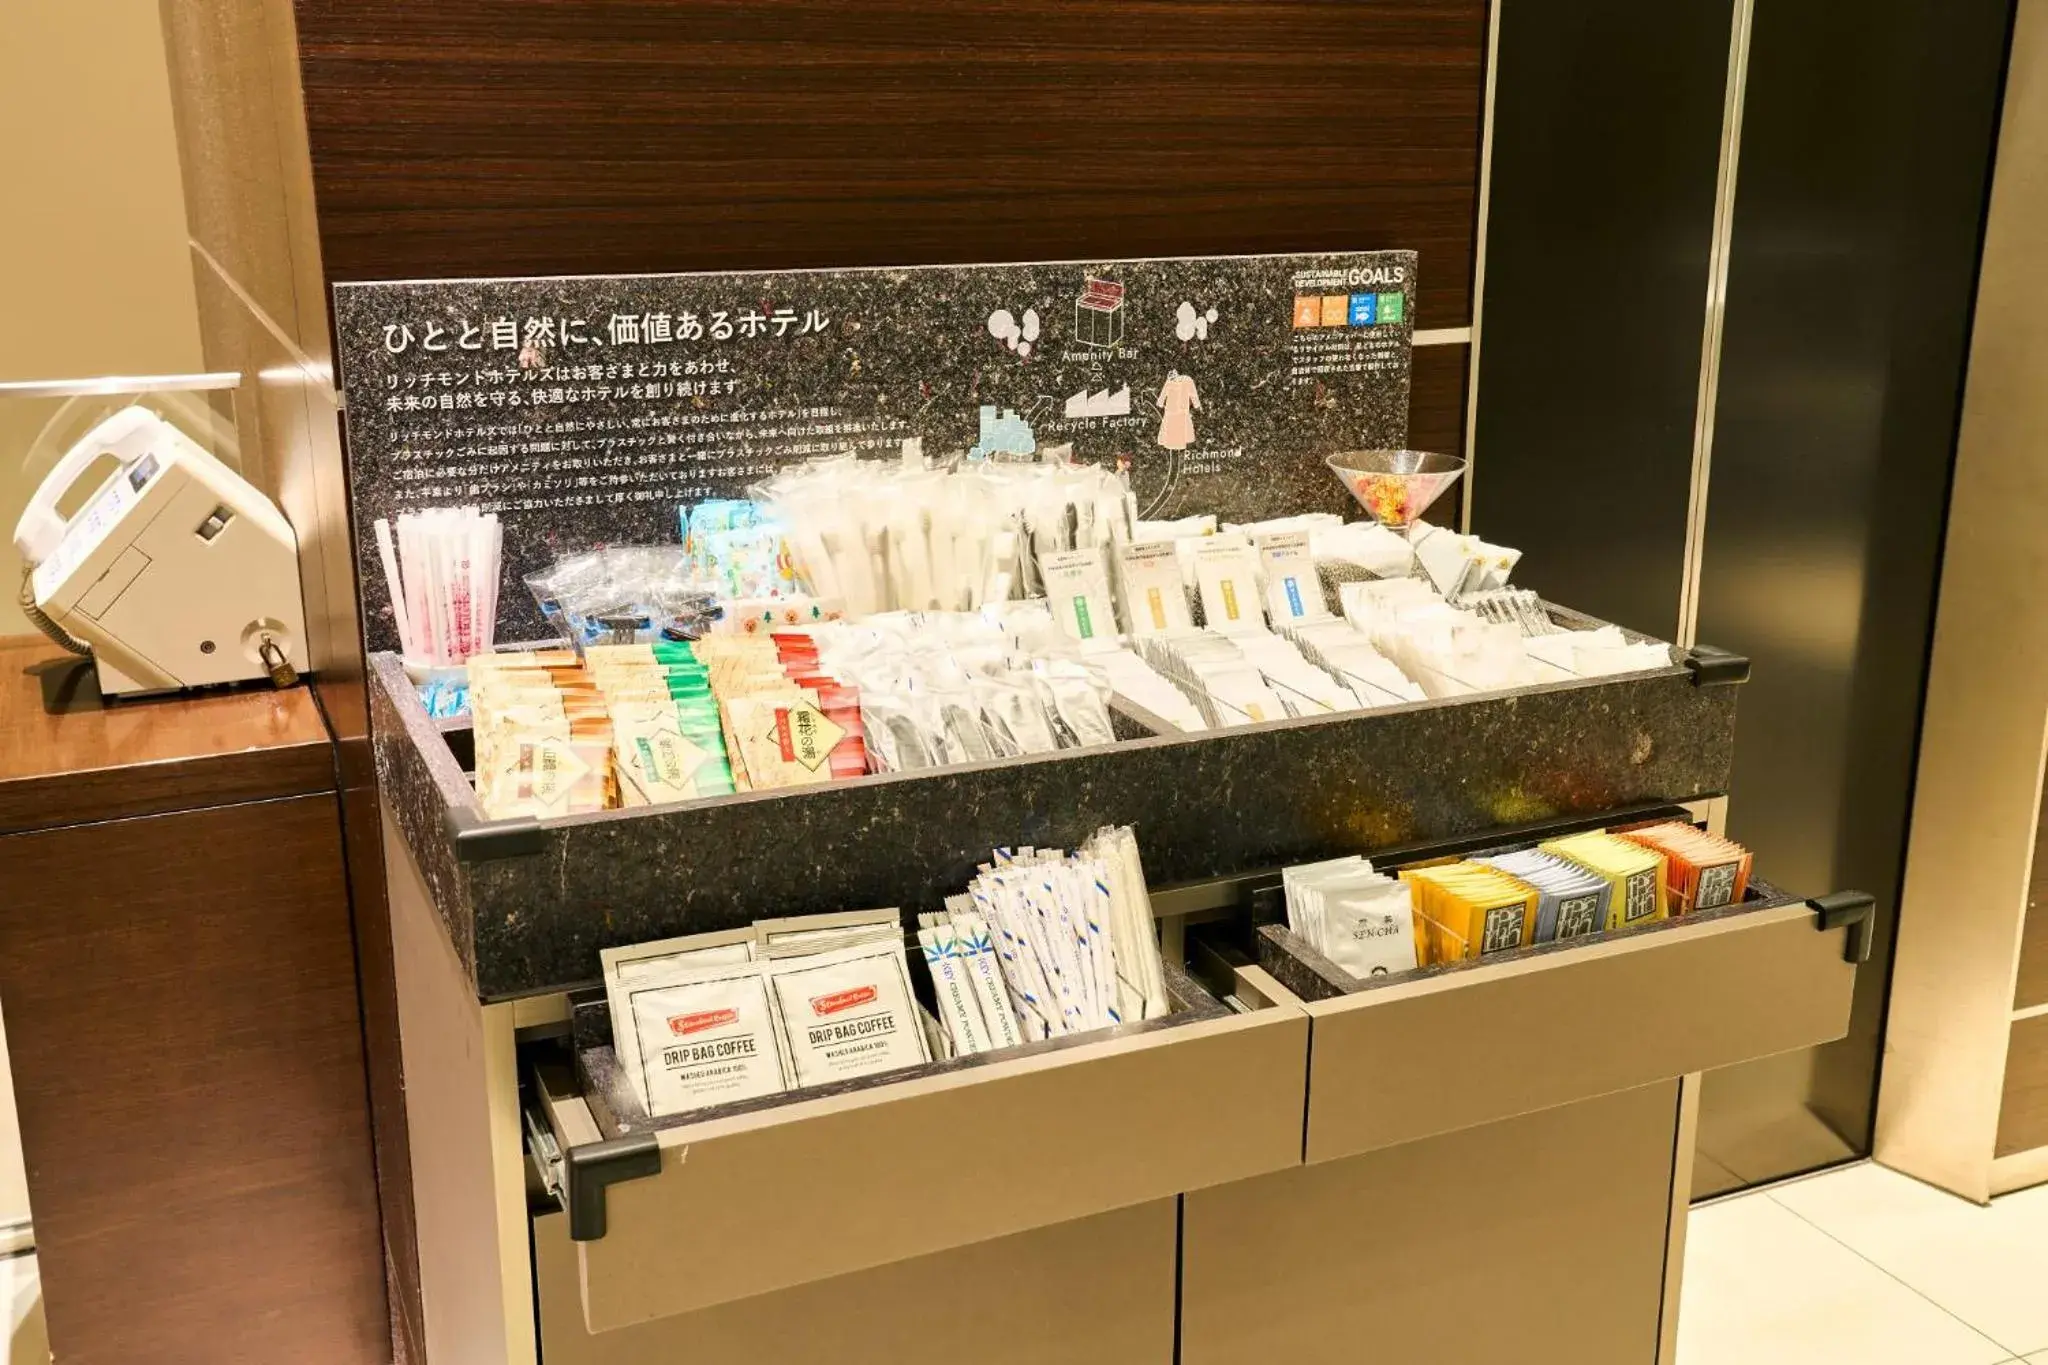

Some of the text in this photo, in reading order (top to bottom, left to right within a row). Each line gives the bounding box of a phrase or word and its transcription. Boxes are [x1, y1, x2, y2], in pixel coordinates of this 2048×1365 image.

[1349, 267, 1404, 285] GOALS
[383, 307, 830, 354] ひとと自然に、価値あるホテル
[1062, 348, 1139, 363] Amenity Bar
[1047, 416, 1148, 433] Recycle Factory
[1183, 447, 1243, 461] Richmond
[1183, 463, 1222, 474] Hotels
[809, 1016, 896, 1043] DRIP BAG COFFEE
[664, 1038, 756, 1066] DRIP BAG COFFEE
